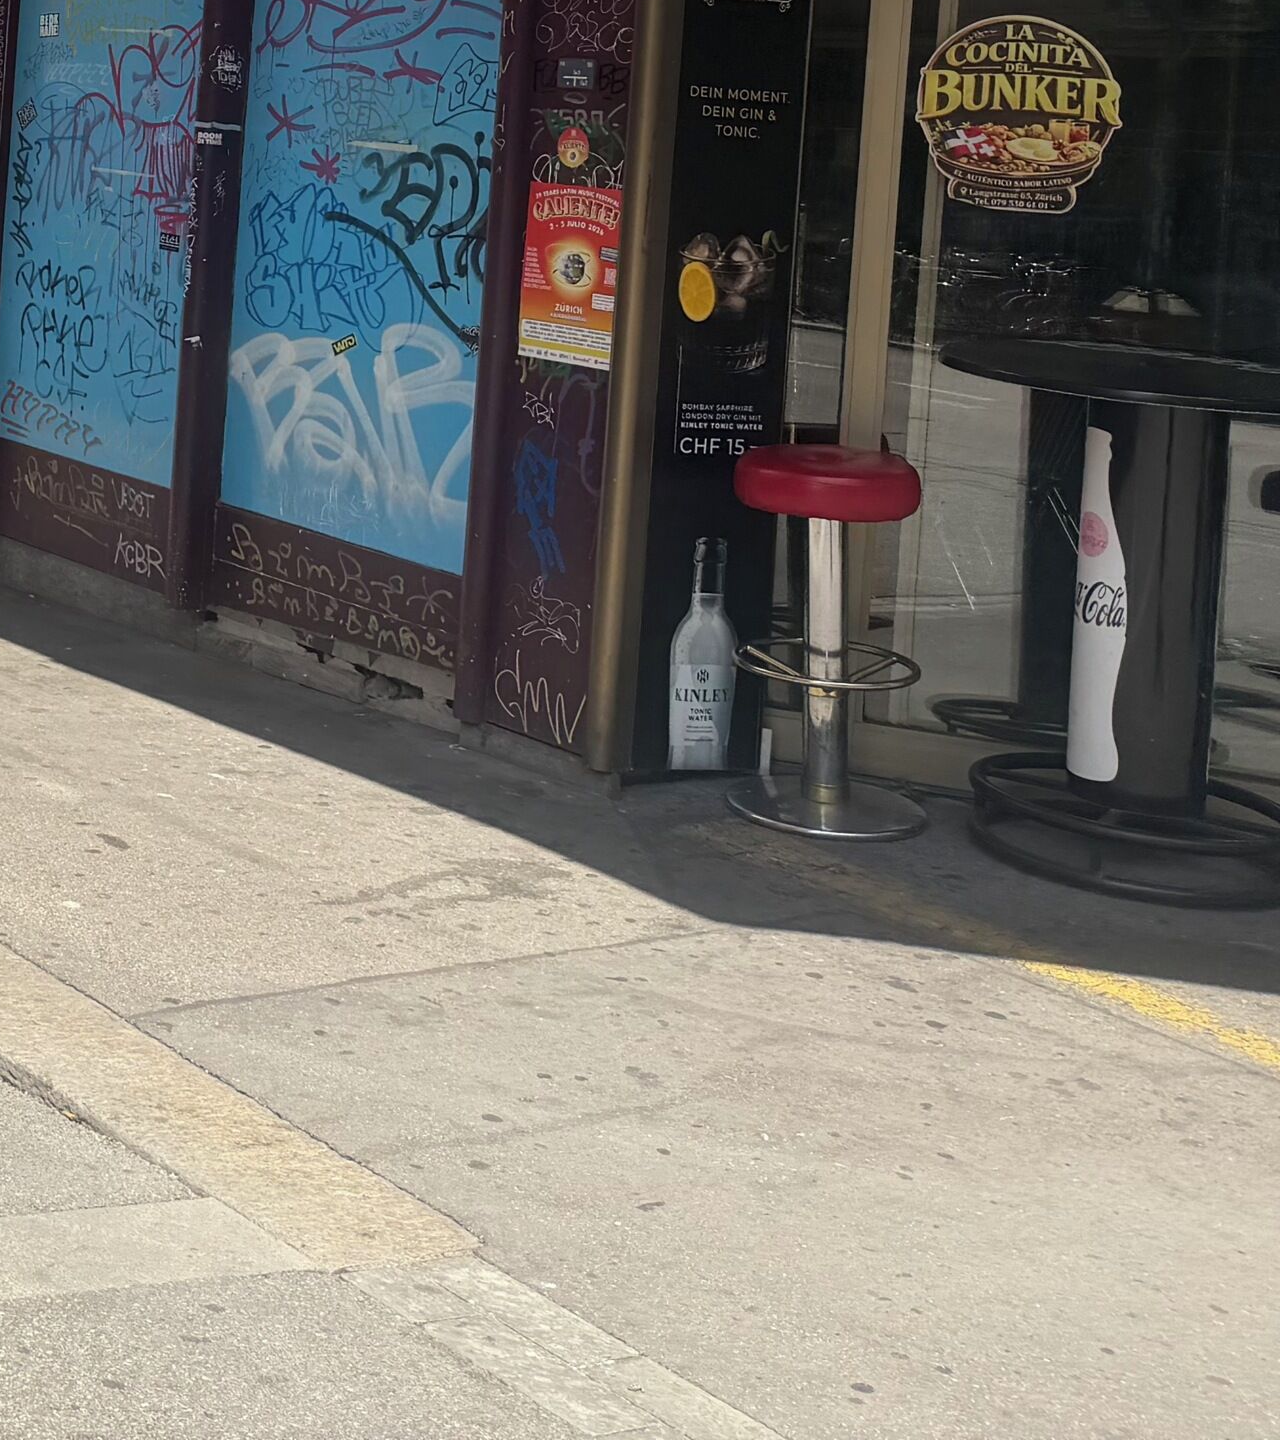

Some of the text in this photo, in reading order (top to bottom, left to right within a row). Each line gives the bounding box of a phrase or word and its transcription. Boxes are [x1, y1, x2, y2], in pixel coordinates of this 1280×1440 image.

[1005, 24, 1036, 40] LA
[945, 41, 1092, 68] COCINITA
[1005, 63, 1032, 73] DEL
[690, 85, 790, 104] DEIN MOMENT.
[919, 70, 1121, 126] BUNKER
[702, 105, 777, 121] DEIN GIN &
[715, 124, 761, 139] TONIC.
[954, 169, 964, 178] EL
[1014, 179, 1041, 188] SABOR
[1043, 177, 1072, 187] LATINO
[969, 188, 1018, 199] Langstrasse
[1034, 192, 1063, 202] Zürich
[533, 195, 620, 230] CALIENTE!
[566, 220, 586, 229] JULIO
[555, 303, 583, 315] ZÜRICH
[682, 403, 753, 412] BOMBAY SAPPHIRE
[682, 412, 713, 420] LONDON
[681, 421, 763, 431] KINLEY TONIC WATER
[680, 437, 721, 455] CHF
[675, 688, 728, 702] KINLEY
